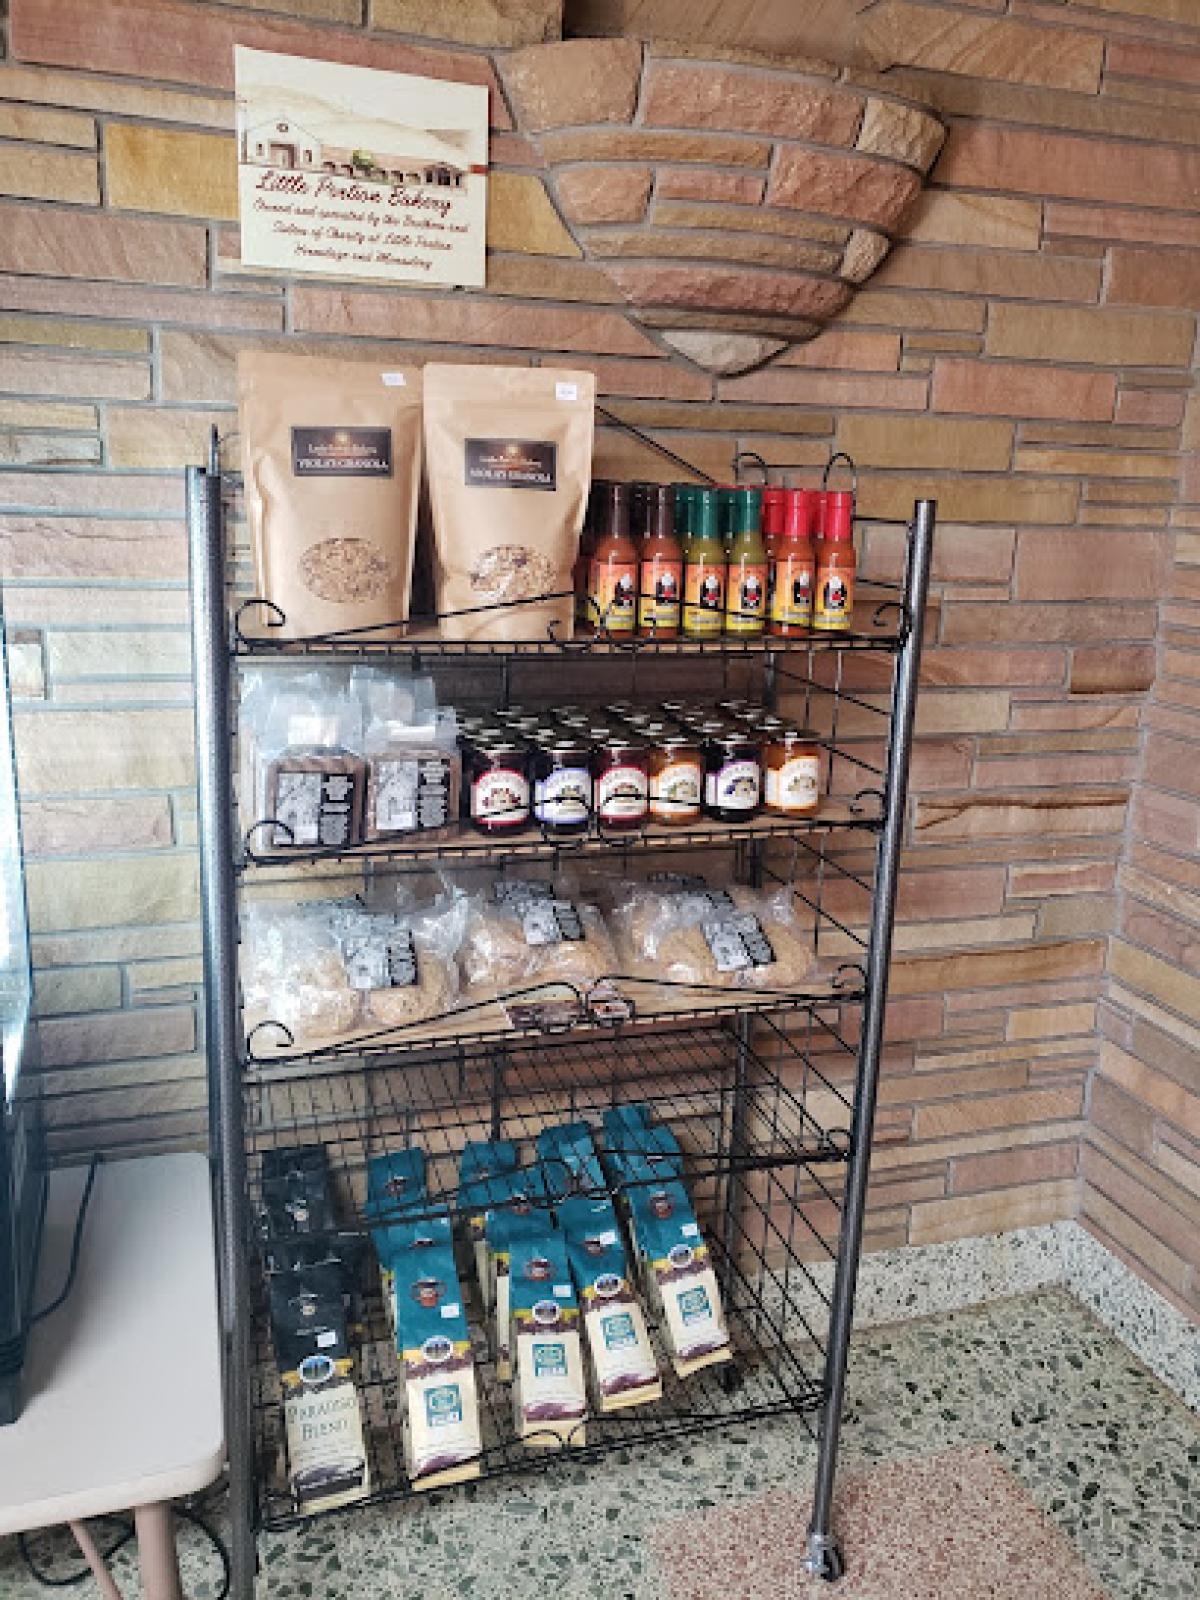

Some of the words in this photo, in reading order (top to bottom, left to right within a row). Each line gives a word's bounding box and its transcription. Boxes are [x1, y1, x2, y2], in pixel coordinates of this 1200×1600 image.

[256, 170, 307, 194] Little
[388, 185, 452, 218] Bakery
[367, 211, 381, 227] by
[448, 221, 470, 233] and
[312, 226, 325, 241] of
[352, 250, 373, 263] and
